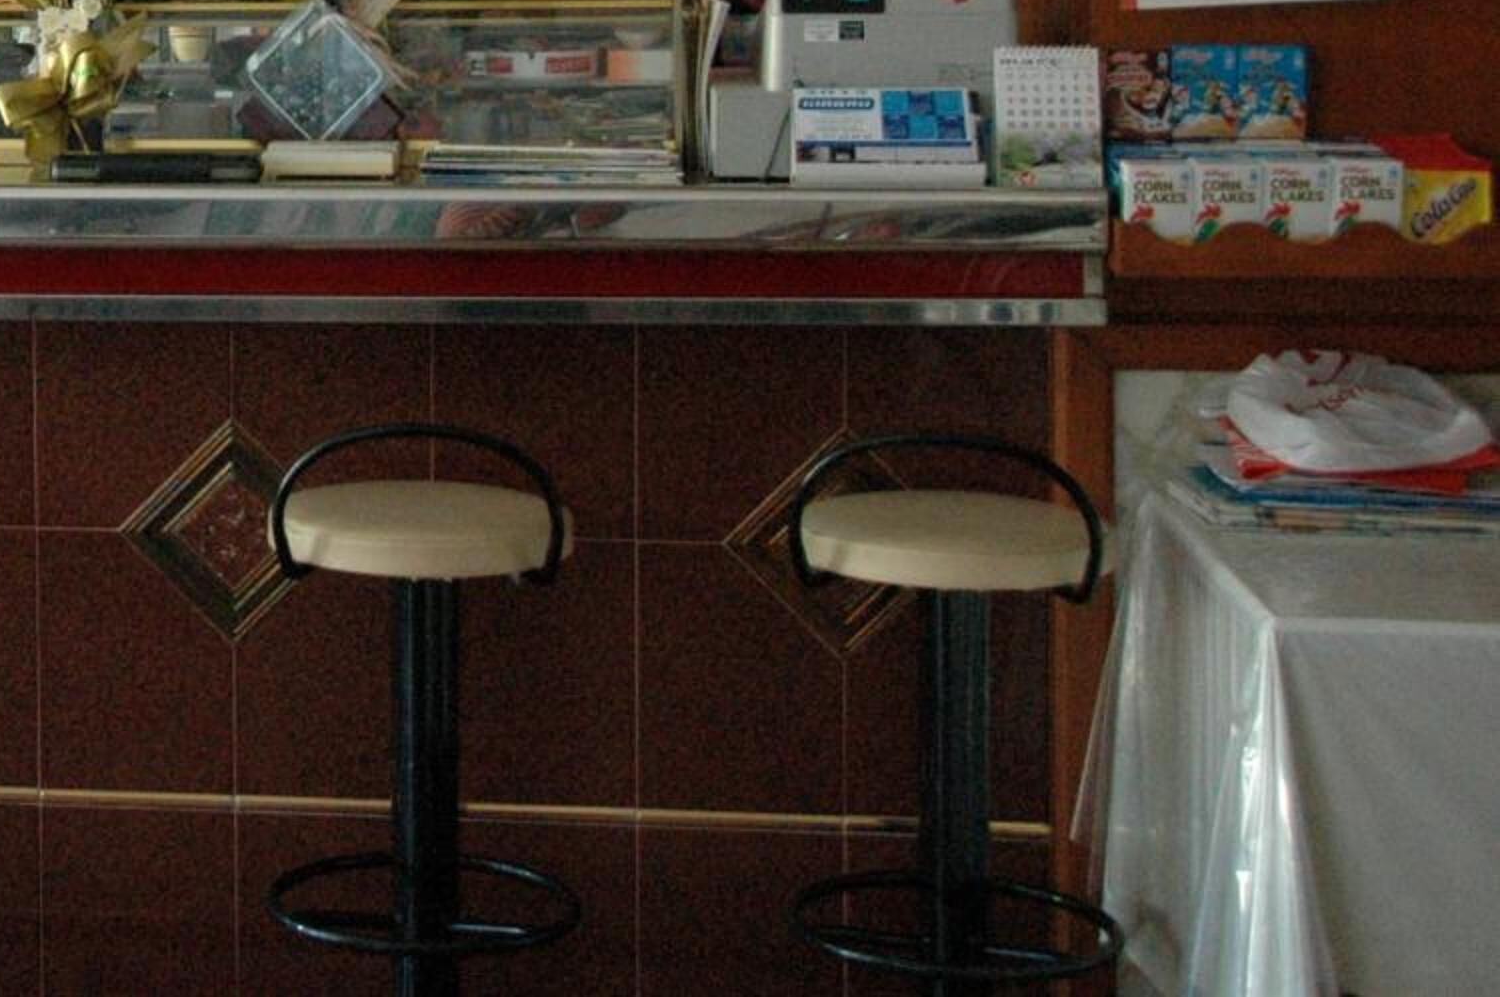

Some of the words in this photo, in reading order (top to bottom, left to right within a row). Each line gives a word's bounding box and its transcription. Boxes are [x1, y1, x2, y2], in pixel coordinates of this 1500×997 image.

[1134, 180, 1173, 191] CORN
[1202, 179, 1242, 191] CORN
[1270, 178, 1311, 190] CORN
[1341, 176, 1381, 188] CORN
[1134, 191, 1186, 203] FLAKES
[1202, 191, 1255, 203] FLAKES
[1270, 190, 1324, 202] FLAKES
[1340, 188, 1396, 200] FLAKES
